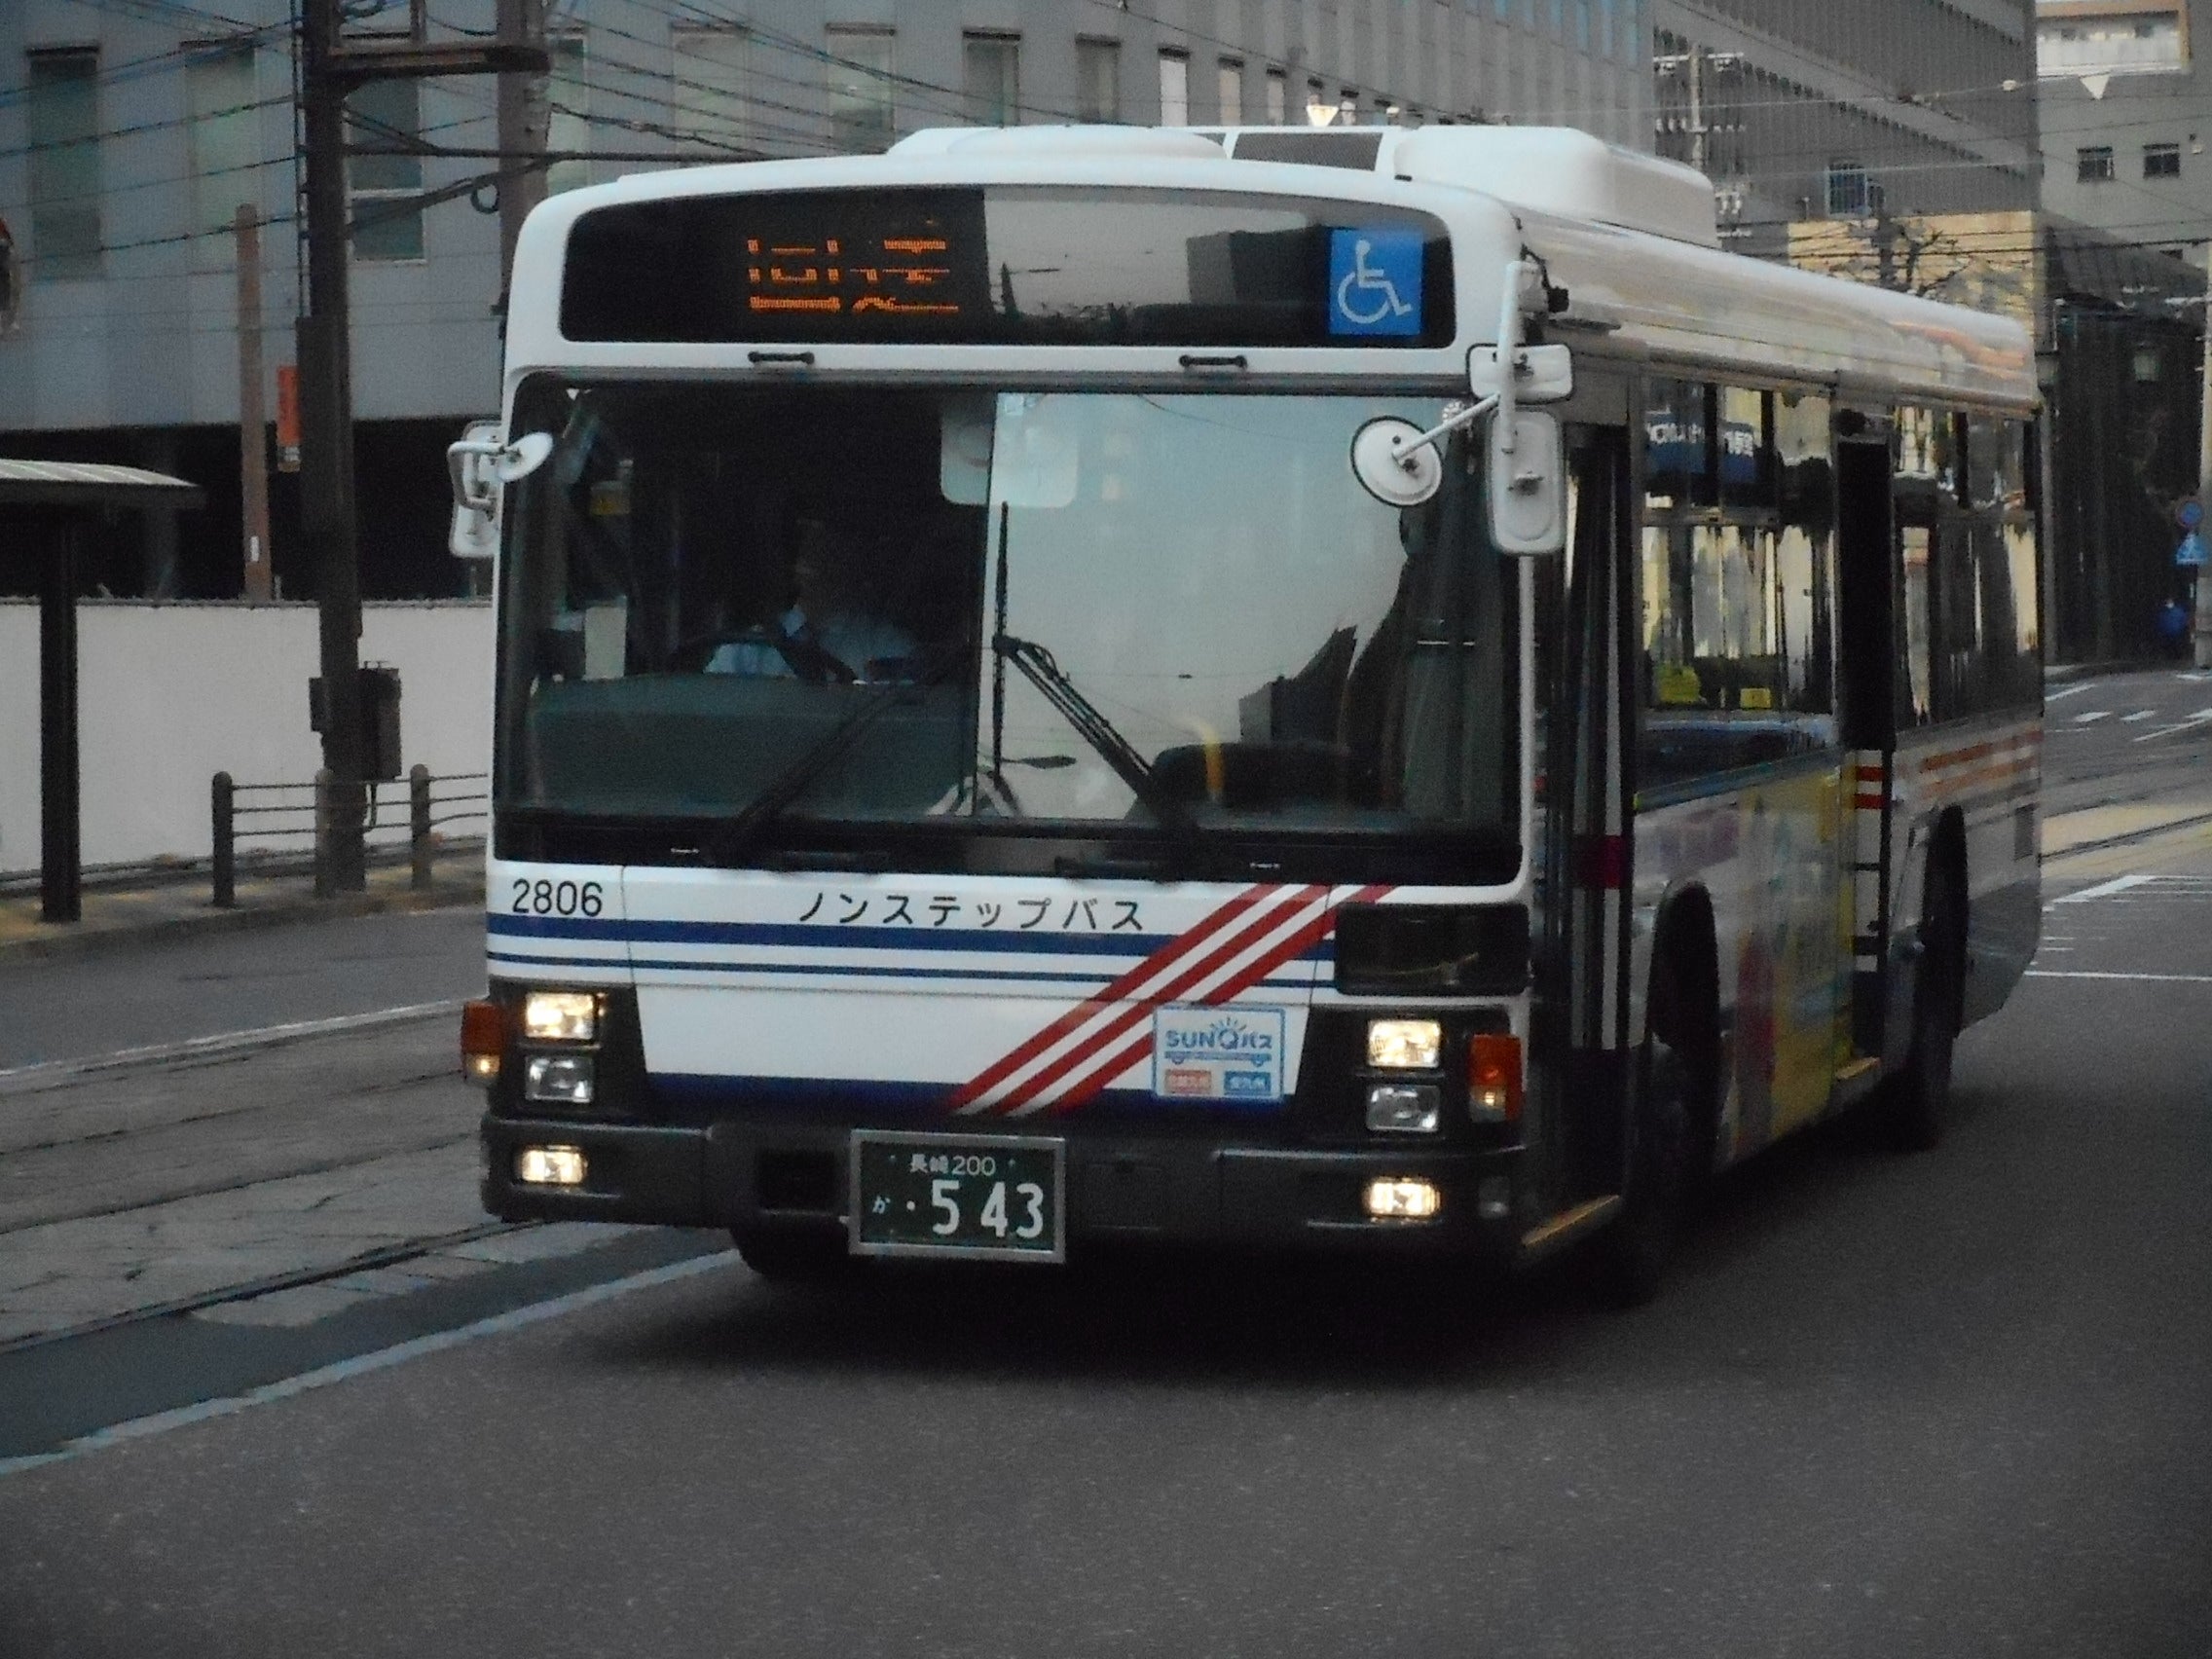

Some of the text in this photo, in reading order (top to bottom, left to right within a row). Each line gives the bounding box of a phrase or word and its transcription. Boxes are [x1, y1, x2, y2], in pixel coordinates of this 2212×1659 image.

[512, 878, 603, 917] 2806
[799, 892, 1143, 932] ノンステップバス
